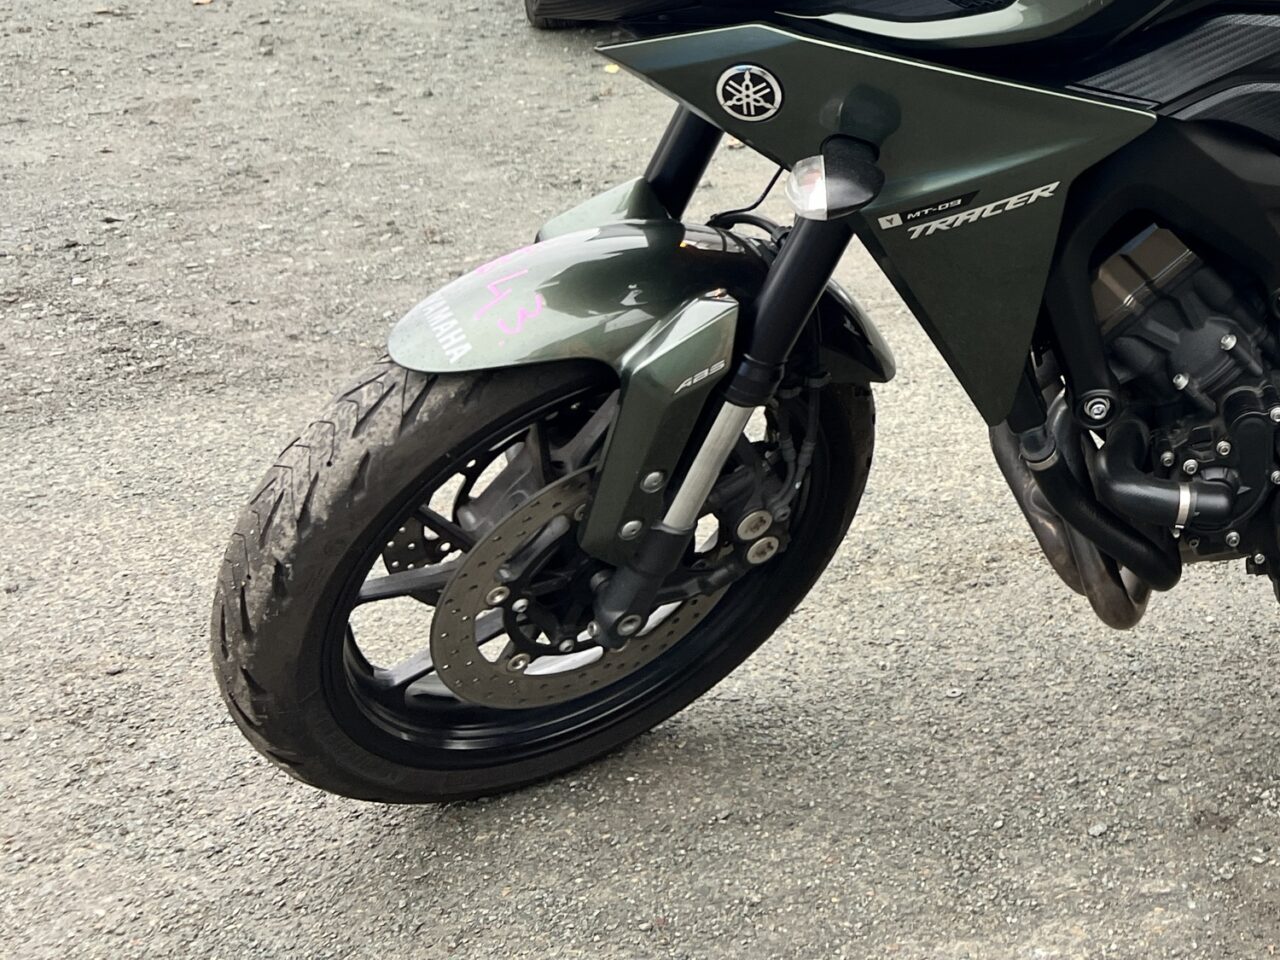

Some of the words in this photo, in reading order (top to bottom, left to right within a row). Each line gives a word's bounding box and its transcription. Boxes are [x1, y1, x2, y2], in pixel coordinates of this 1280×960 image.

[907, 198, 962, 220] MT-09
[907, 181, 1061, 240] TRACER
[674, 360, 725, 394] ABS
